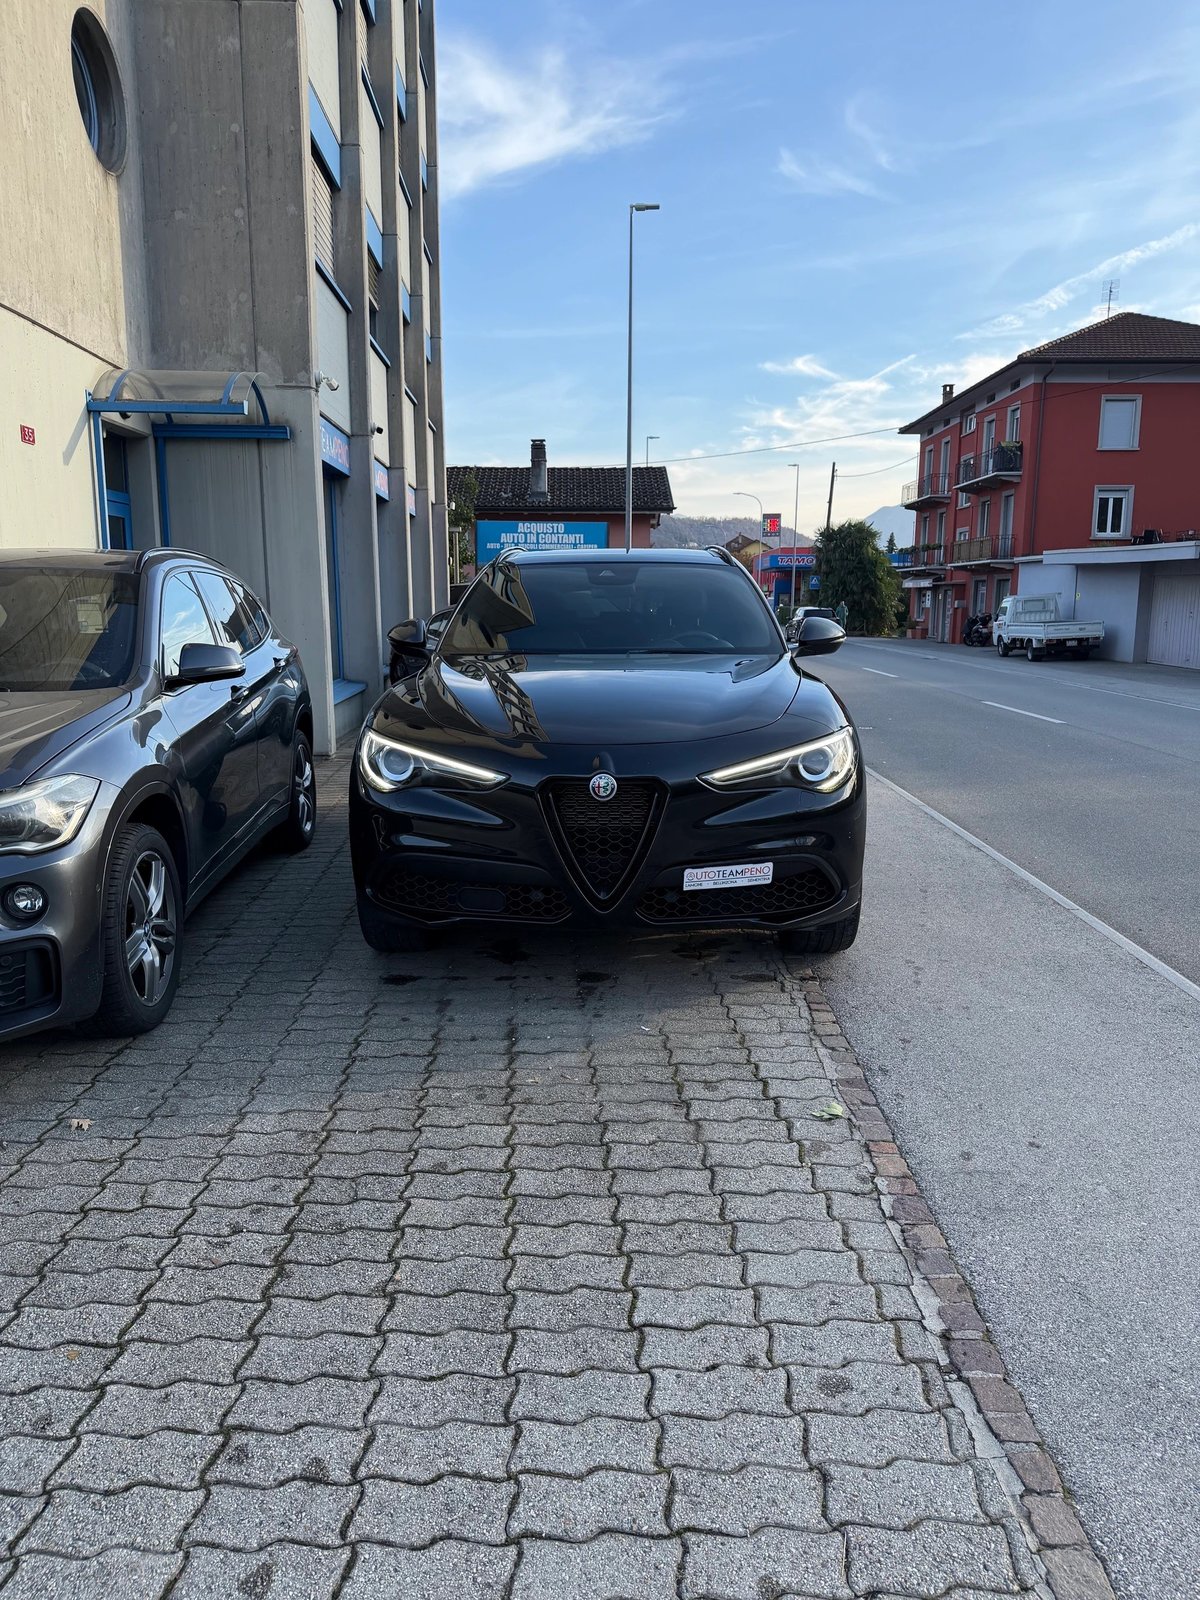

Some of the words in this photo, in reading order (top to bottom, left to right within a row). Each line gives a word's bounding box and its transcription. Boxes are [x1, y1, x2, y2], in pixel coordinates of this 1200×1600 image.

[24, 427, 33, 441] 35
[518, 523, 564, 534] ACQUISTO
[500, 533, 524, 543] AUTO
[527, 534, 536, 543] IN
[539, 534, 584, 544] CONTANTI
